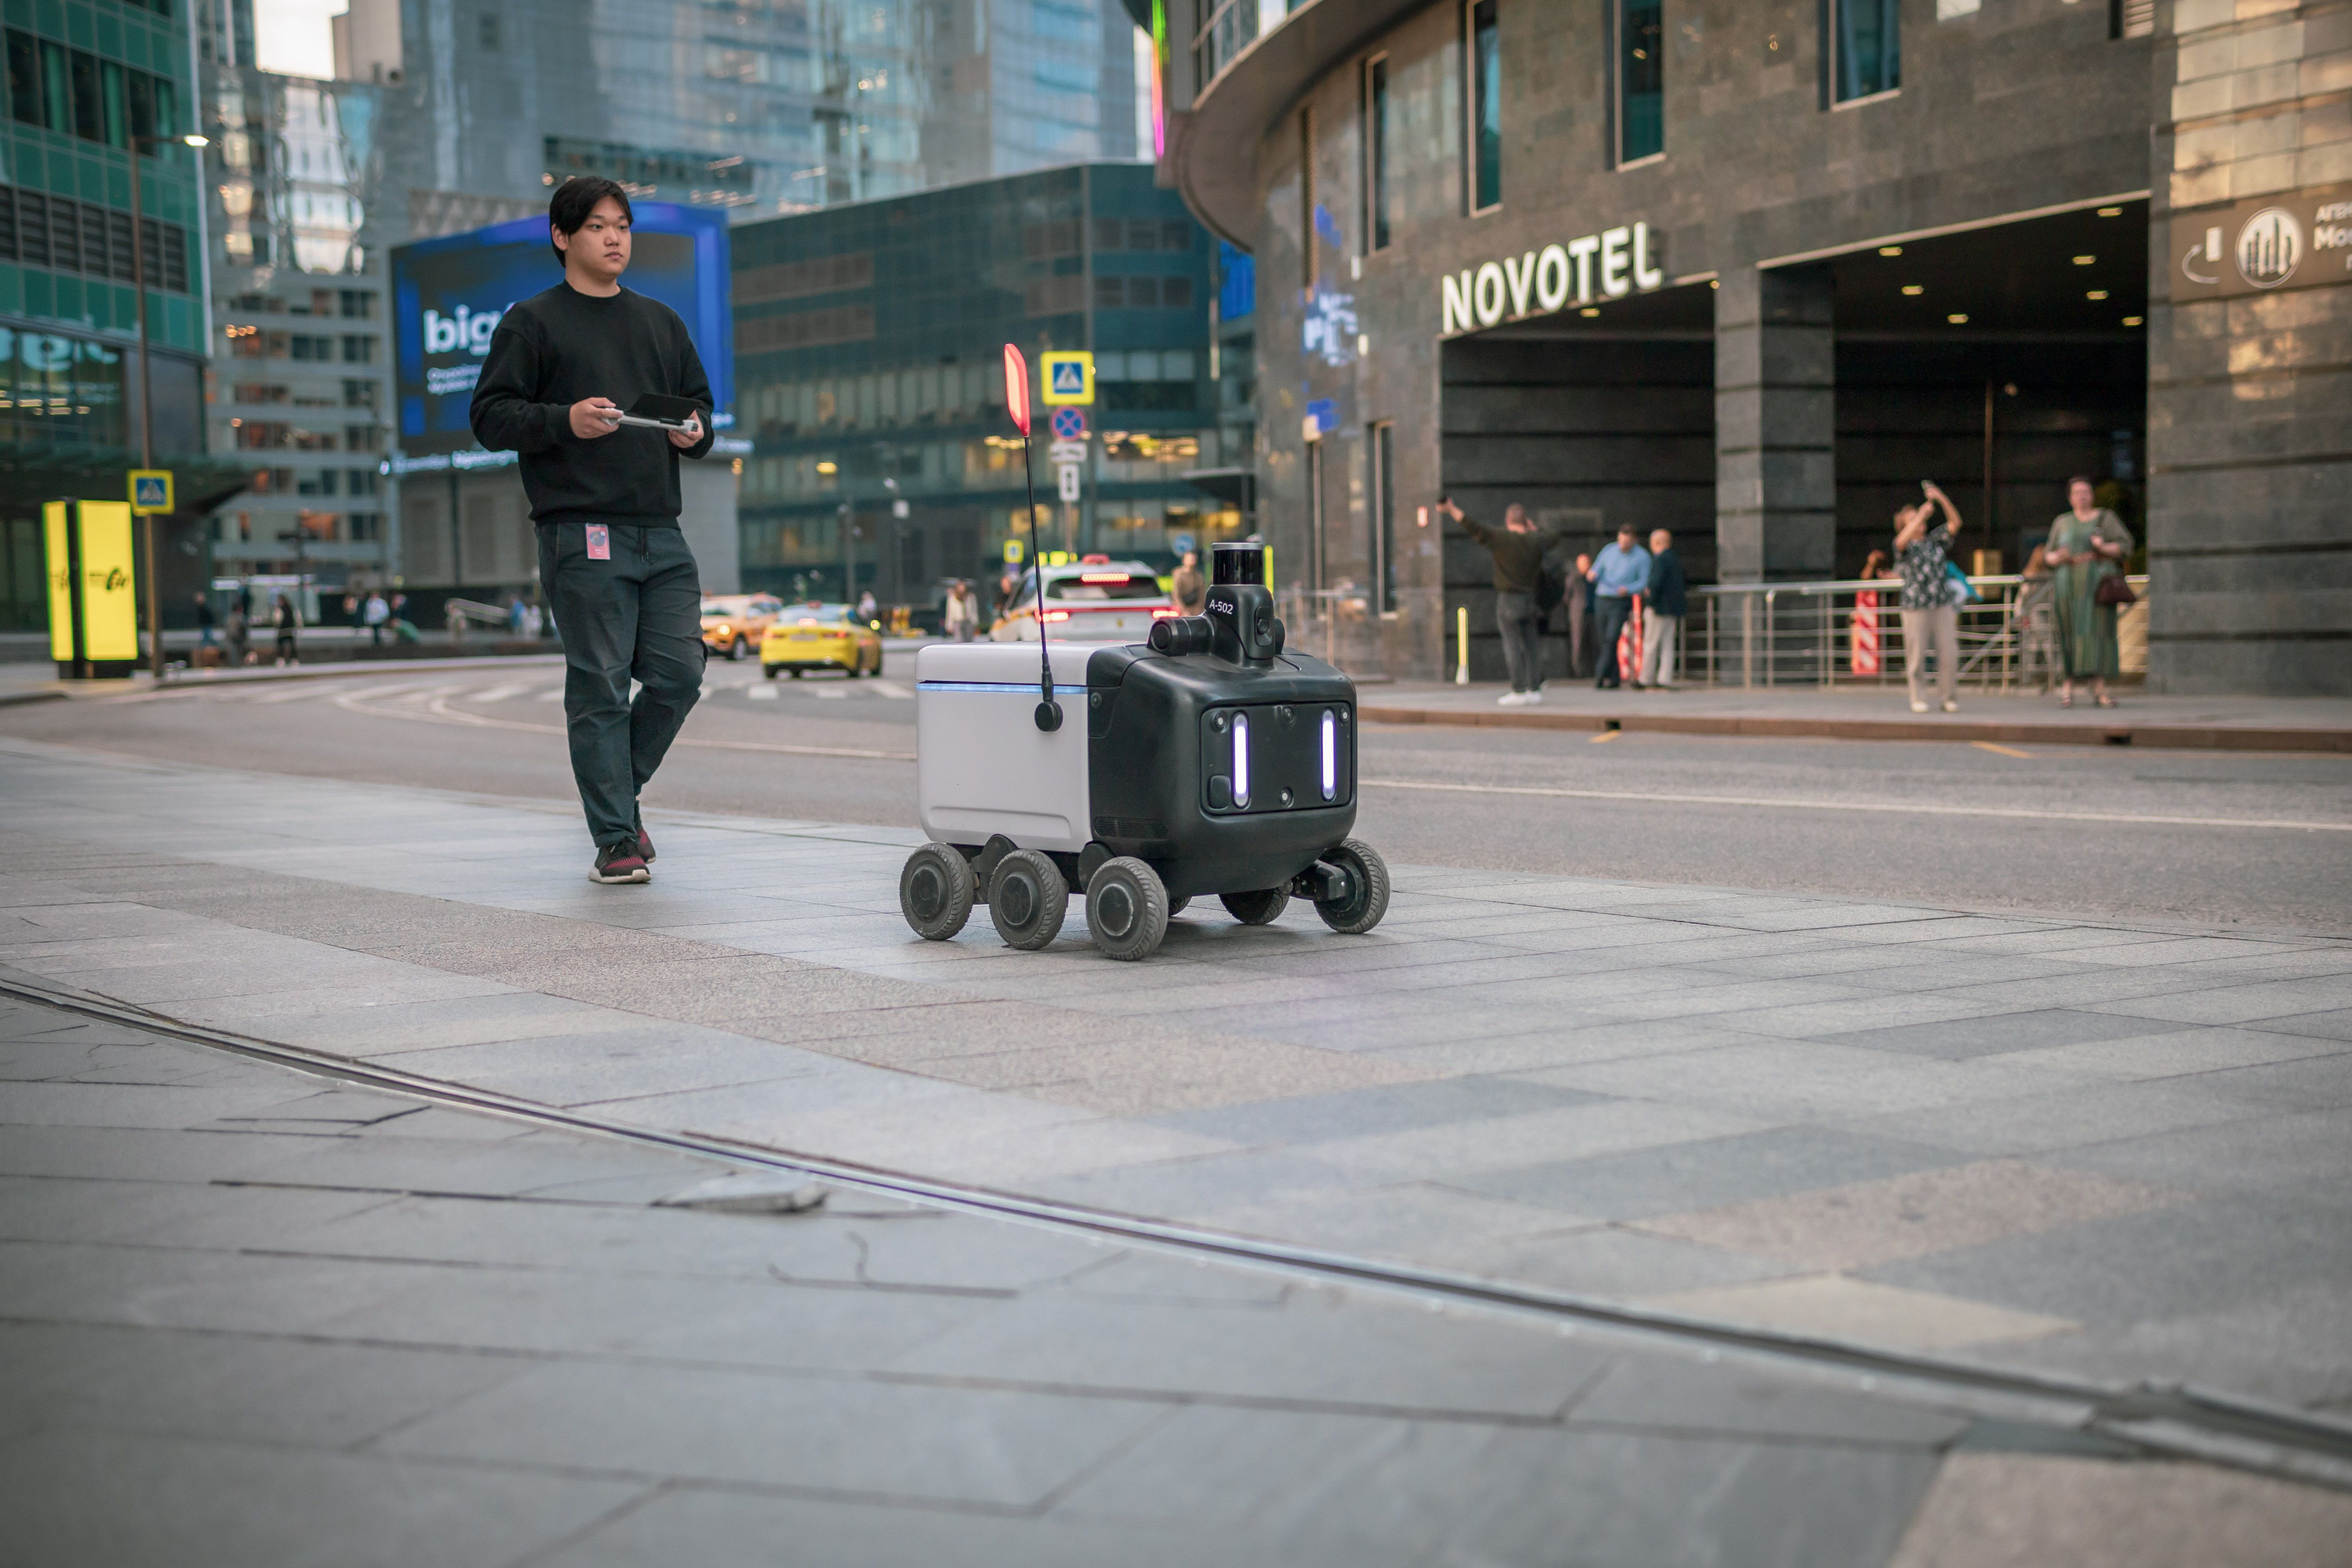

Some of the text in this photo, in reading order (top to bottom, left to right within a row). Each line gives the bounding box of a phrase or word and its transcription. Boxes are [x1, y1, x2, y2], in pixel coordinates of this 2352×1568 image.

[1442, 221, 1663, 335] NOVOTEL
[423, 302, 516, 356] big
[1209, 599, 1233, 615] A-502
